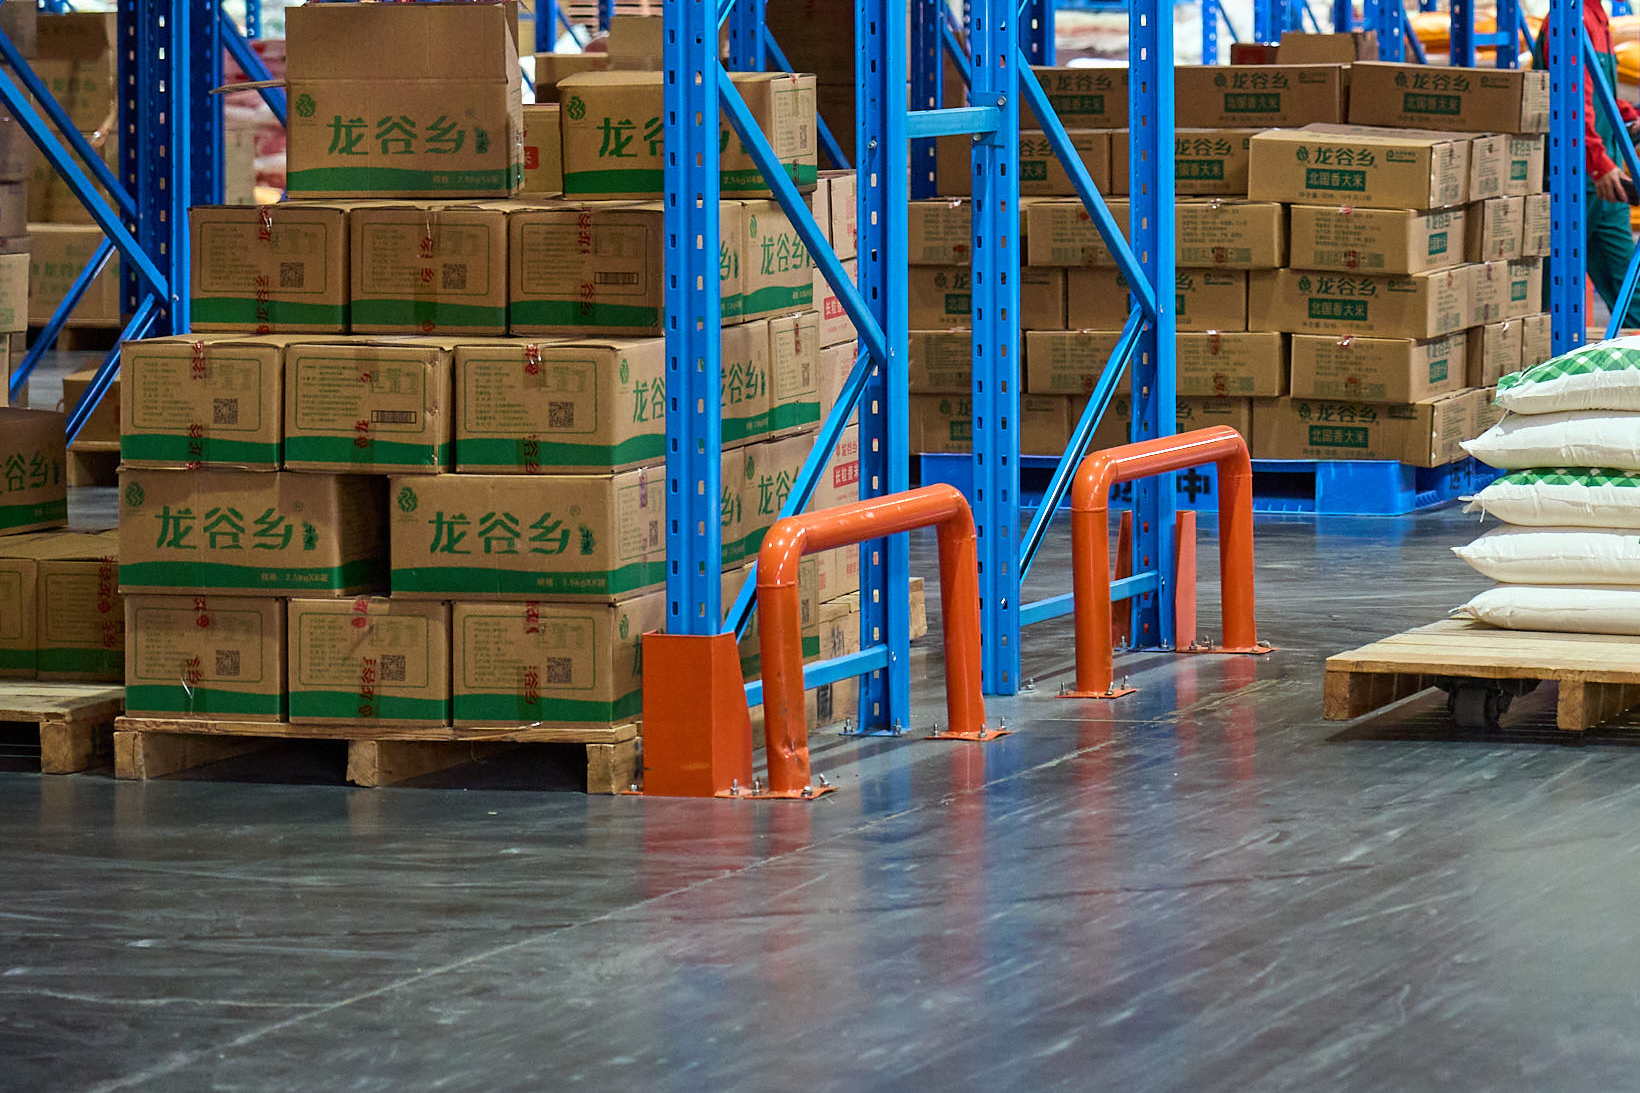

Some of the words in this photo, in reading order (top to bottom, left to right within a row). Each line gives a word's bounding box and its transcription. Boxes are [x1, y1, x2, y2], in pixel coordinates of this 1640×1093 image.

[1231, 73, 1288, 90] 龙谷乡
[1413, 73, 1470, 92] 龙谷乡
[326, 116, 465, 156] 龙谷乡
[1314, 147, 1376, 166] 龙谷乡
[1308, 171, 1365, 189] 北国香大米
[1316, 276, 1377, 296] 龙谷乡
[1316, 404, 1377, 423] 龙谷乡
[0, 451, 48, 494] 谷乡
[156, 506, 293, 550] 龙谷乡
[429, 510, 571, 555] 龙谷乡
